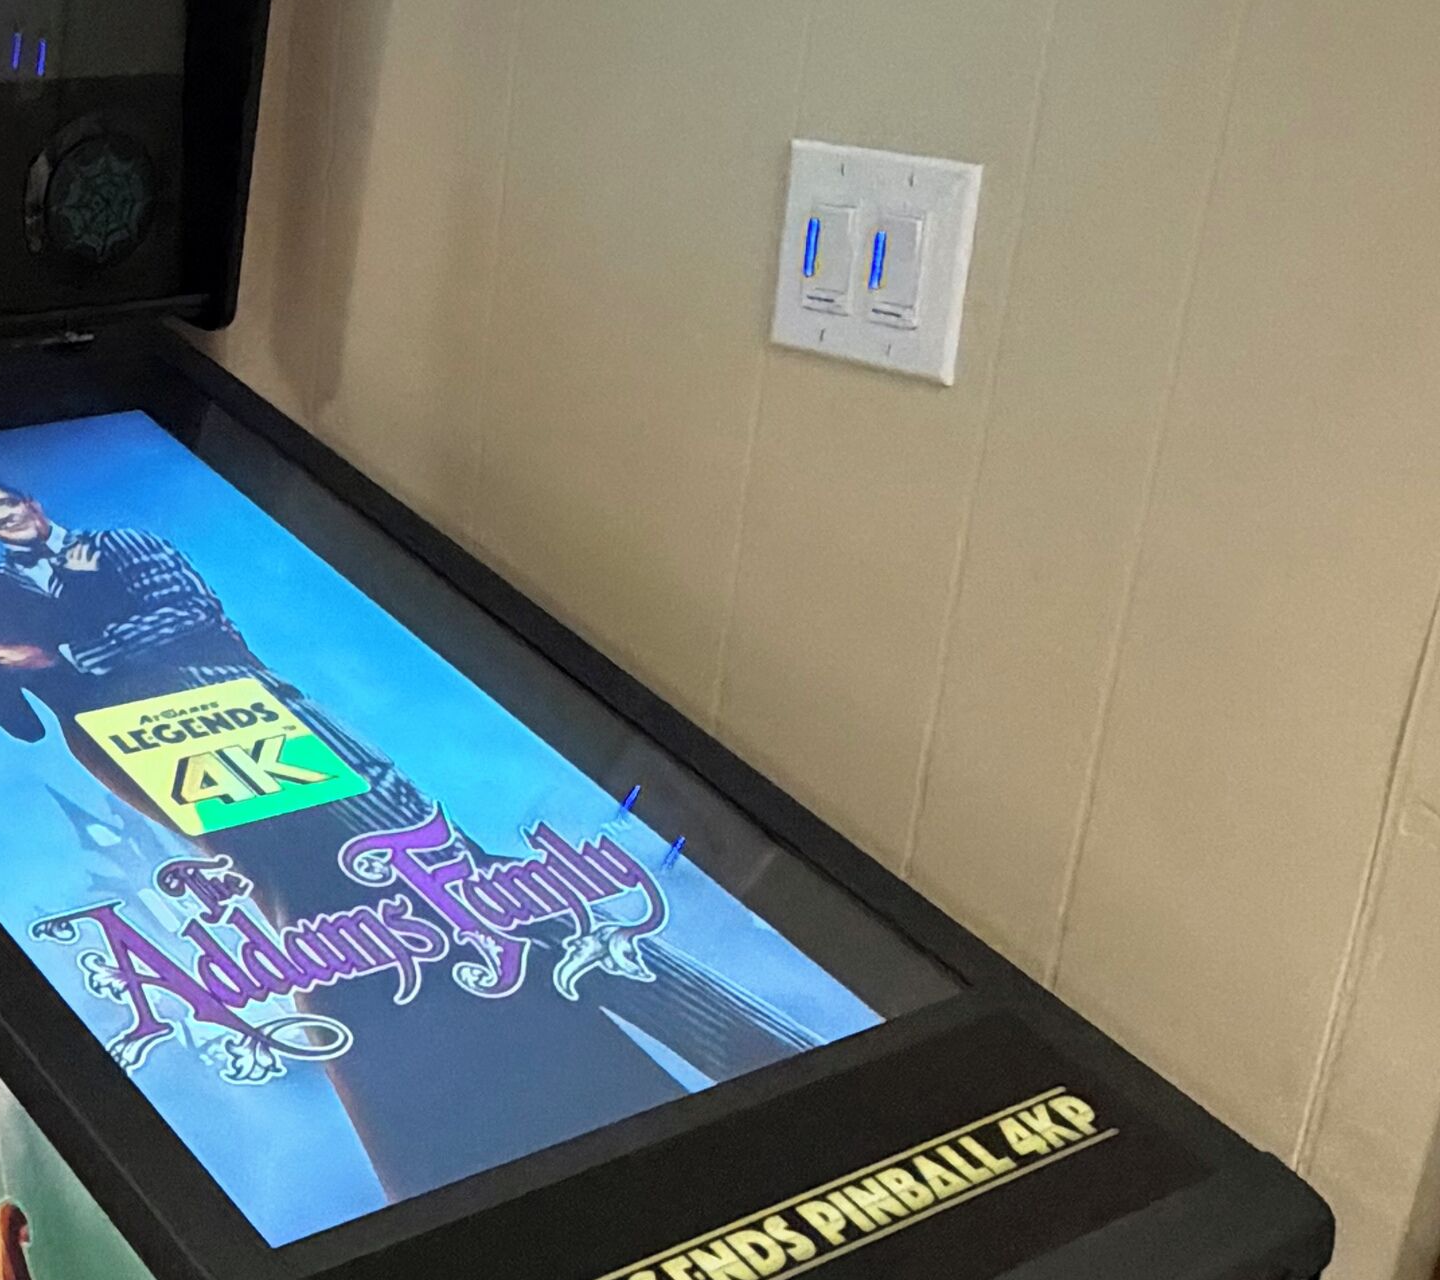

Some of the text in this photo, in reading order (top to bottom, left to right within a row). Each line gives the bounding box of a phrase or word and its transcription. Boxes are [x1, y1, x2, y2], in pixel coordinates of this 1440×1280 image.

[108, 702, 280, 755] LEGENDS
[171, 733, 339, 806] 4K
[153, 854, 255, 925] The
[29, 800, 669, 1085] Addams Family
[796, 1130, 1017, 1247] PINBALL
[997, 1093, 1098, 1158] 4KP
